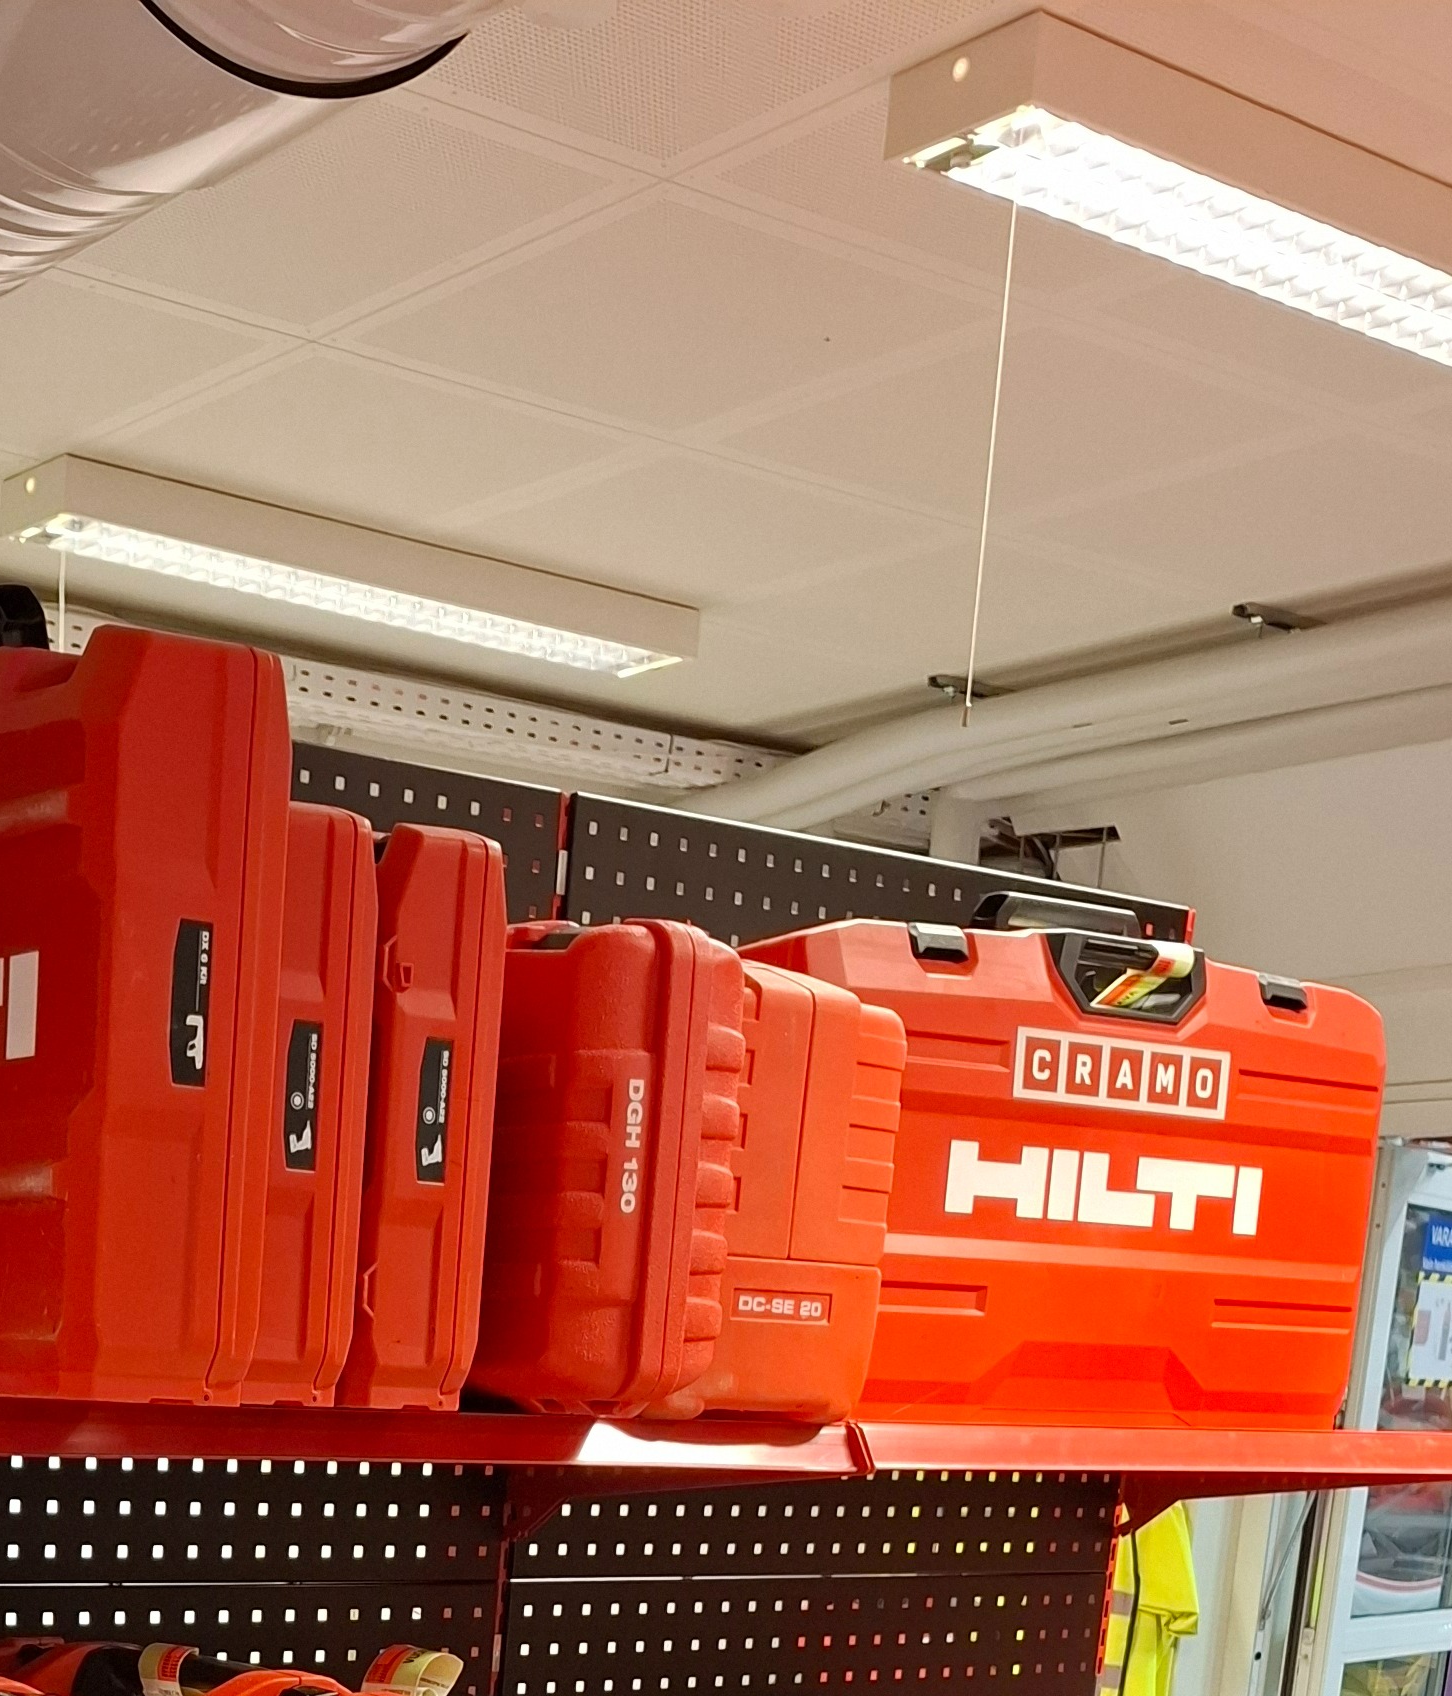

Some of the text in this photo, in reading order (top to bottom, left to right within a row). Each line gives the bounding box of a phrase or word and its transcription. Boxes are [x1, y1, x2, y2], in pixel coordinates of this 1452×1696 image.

[1031, 1048, 1215, 1100] CRAMO
[620, 1078, 645, 1214] DGH 130
[944, 1139, 1263, 1237] HILTI
[738, 1294, 822, 1318] DC-SE 20
